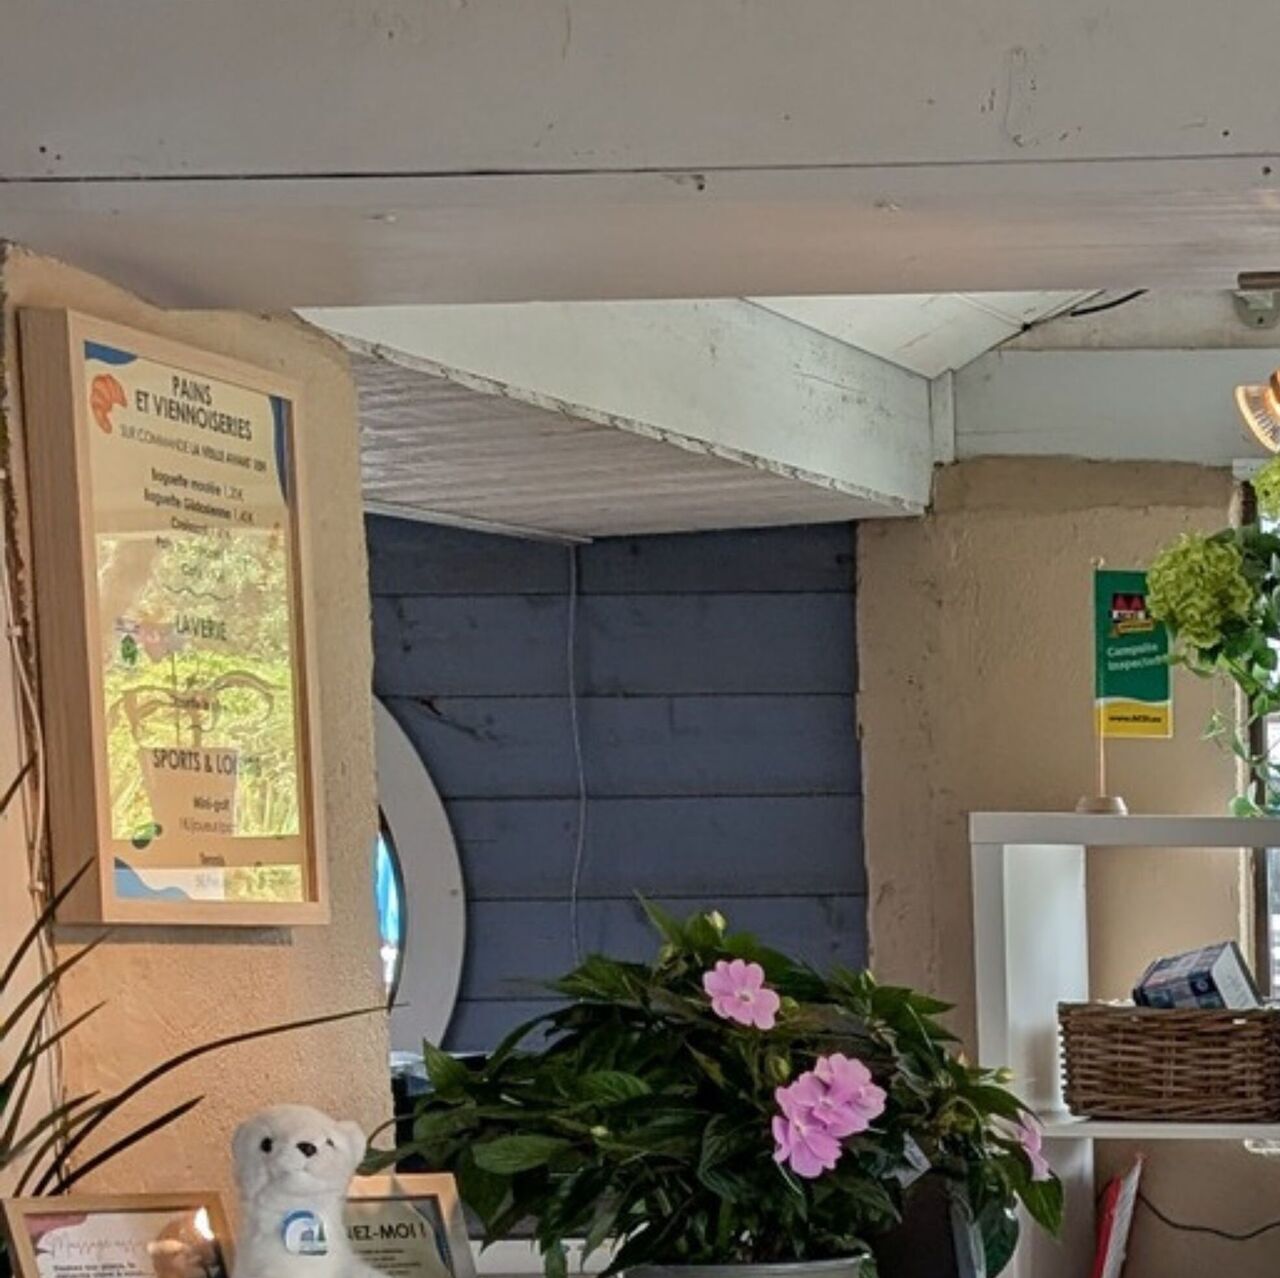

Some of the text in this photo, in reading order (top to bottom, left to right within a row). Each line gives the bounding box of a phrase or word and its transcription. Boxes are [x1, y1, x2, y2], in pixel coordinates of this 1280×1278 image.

[171, 375, 213, 407] PAINS
[135, 390, 252, 441] ET VIENNOISERIES
[153, 749, 200, 772] SPORTS
[203, 754, 213, 773] &
